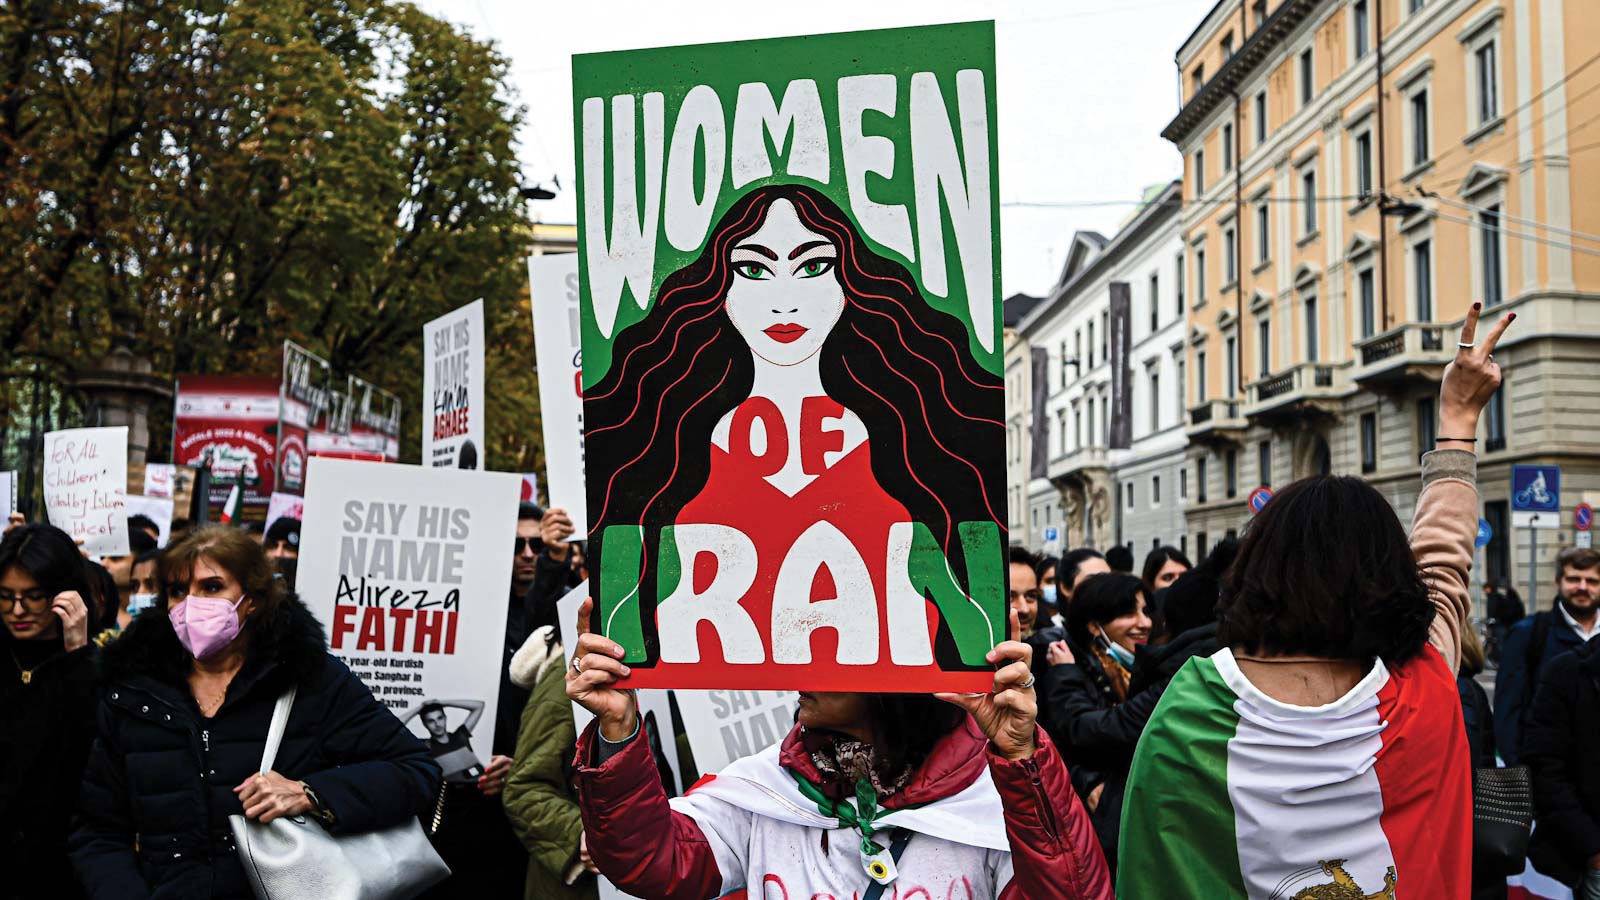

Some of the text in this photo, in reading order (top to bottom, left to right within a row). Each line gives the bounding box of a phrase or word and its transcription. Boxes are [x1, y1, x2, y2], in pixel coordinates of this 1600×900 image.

[582, 68, 995, 355] WOMEN
[434, 318, 470, 358] SAY HIS
[434, 349, 469, 393] NAME
[433, 406, 469, 440] AGHAEE
[728, 395, 845, 476] OF
[343, 500, 471, 540] SAY HIS
[338, 536, 465, 585] NAME
[335, 574, 460, 612] Alireza
[600, 519, 1004, 667] IRAN
[331, 604, 459, 655] FATHI
[374, 671, 411, 682] Sanghar
[413, 672, 422, 682] in
[390, 658, 424, 669] Kurdish
[383, 685, 425, 697] province,
